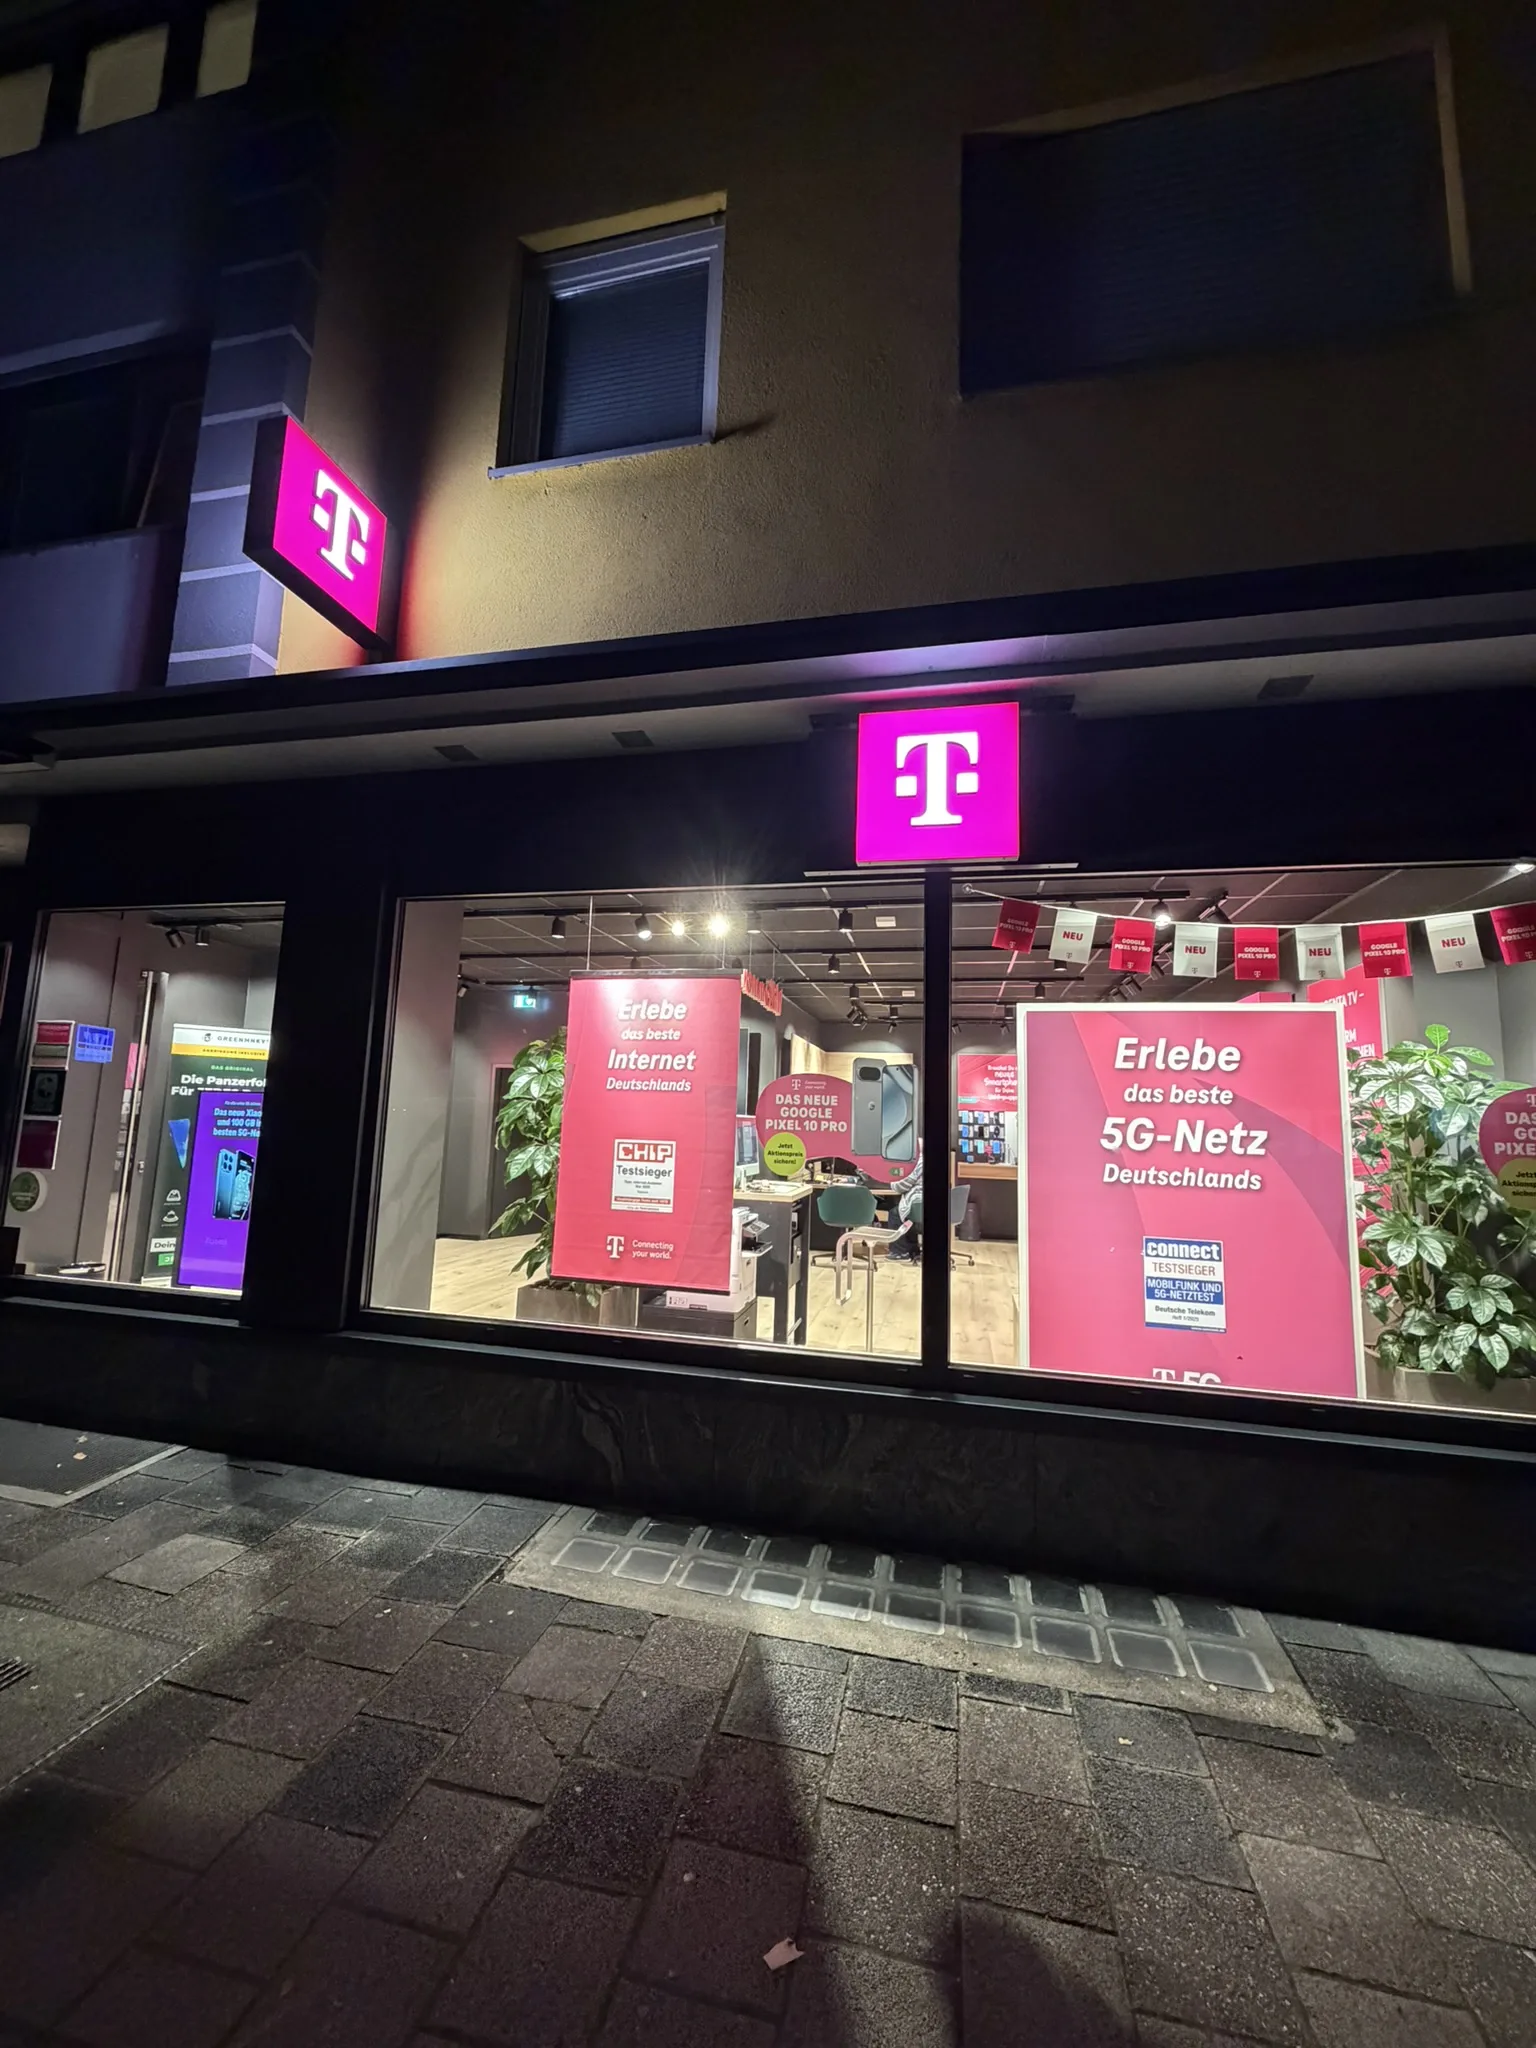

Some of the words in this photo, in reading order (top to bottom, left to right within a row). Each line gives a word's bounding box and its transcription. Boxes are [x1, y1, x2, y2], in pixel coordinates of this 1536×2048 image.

[896, 731, 979, 826] T
[1007, 918, 1029, 926] GOOGLE
[1062, 930, 1083, 941] NEU
[1114, 943, 1132, 951] PIXEL
[1138, 944, 1151, 953] PRO
[1121, 938, 1145, 946] GOOGLE
[1370, 942, 1397, 950] GOOGLE
[1441, 937, 1465, 948] NEU
[1184, 945, 1206, 955] NEU
[1308, 948, 1331, 957] NEU
[1364, 949, 1383, 957] PIXEL
[1391, 948, 1406, 956] PRO
[618, 999, 687, 1020] Erlebe
[621, 1026, 644, 1040] das
[646, 1027, 681, 1040] beste
[607, 1048, 696, 1071] Internet
[1114, 1037, 1241, 1072] Erlebe
[180, 1074, 204, 1085] Die
[606, 1077, 692, 1091] Deutschlands
[171, 1086, 195, 1096] Für
[1123, 1083, 1164, 1102] das
[1169, 1084, 1234, 1105] beste
[775, 1094, 800, 1105] DAS
[804, 1094, 838, 1106] NEUE
[213, 1107, 228, 1117] Das
[228, 1109, 245, 1117] neue
[780, 1106, 832, 1118] GOOGLE
[231, 1118, 244, 1127] 100
[245, 1119, 255, 1128] GB
[765, 1119, 801, 1131] PIXEL
[803, 1120, 818, 1131] 10
[820, 1121, 847, 1132] PRO
[213, 1127, 237, 1136] besten
[1099, 1116, 1268, 1156] 5G-Netz
[618, 1143, 672, 1161] CHIP
[616, 1164, 672, 1179] Testsieger
[1103, 1163, 1263, 1190] Deutschlands
[632, 1239, 673, 1252] Connecting
[1146, 1242, 1220, 1260] connect
[632, 1250, 648, 1259] your
[649, 1251, 672, 1259] world.
[1152, 1262, 1216, 1276] TESTSIEGER
[1147, 1278, 1201, 1292] MOBILFUNK
[1202, 1283, 1221, 1293] UND
[1154, 1289, 1215, 1302] 5G-NETZTEST
[1155, 1305, 1186, 1315] Deutsche
[1187, 1307, 1216, 1317] Telekom
